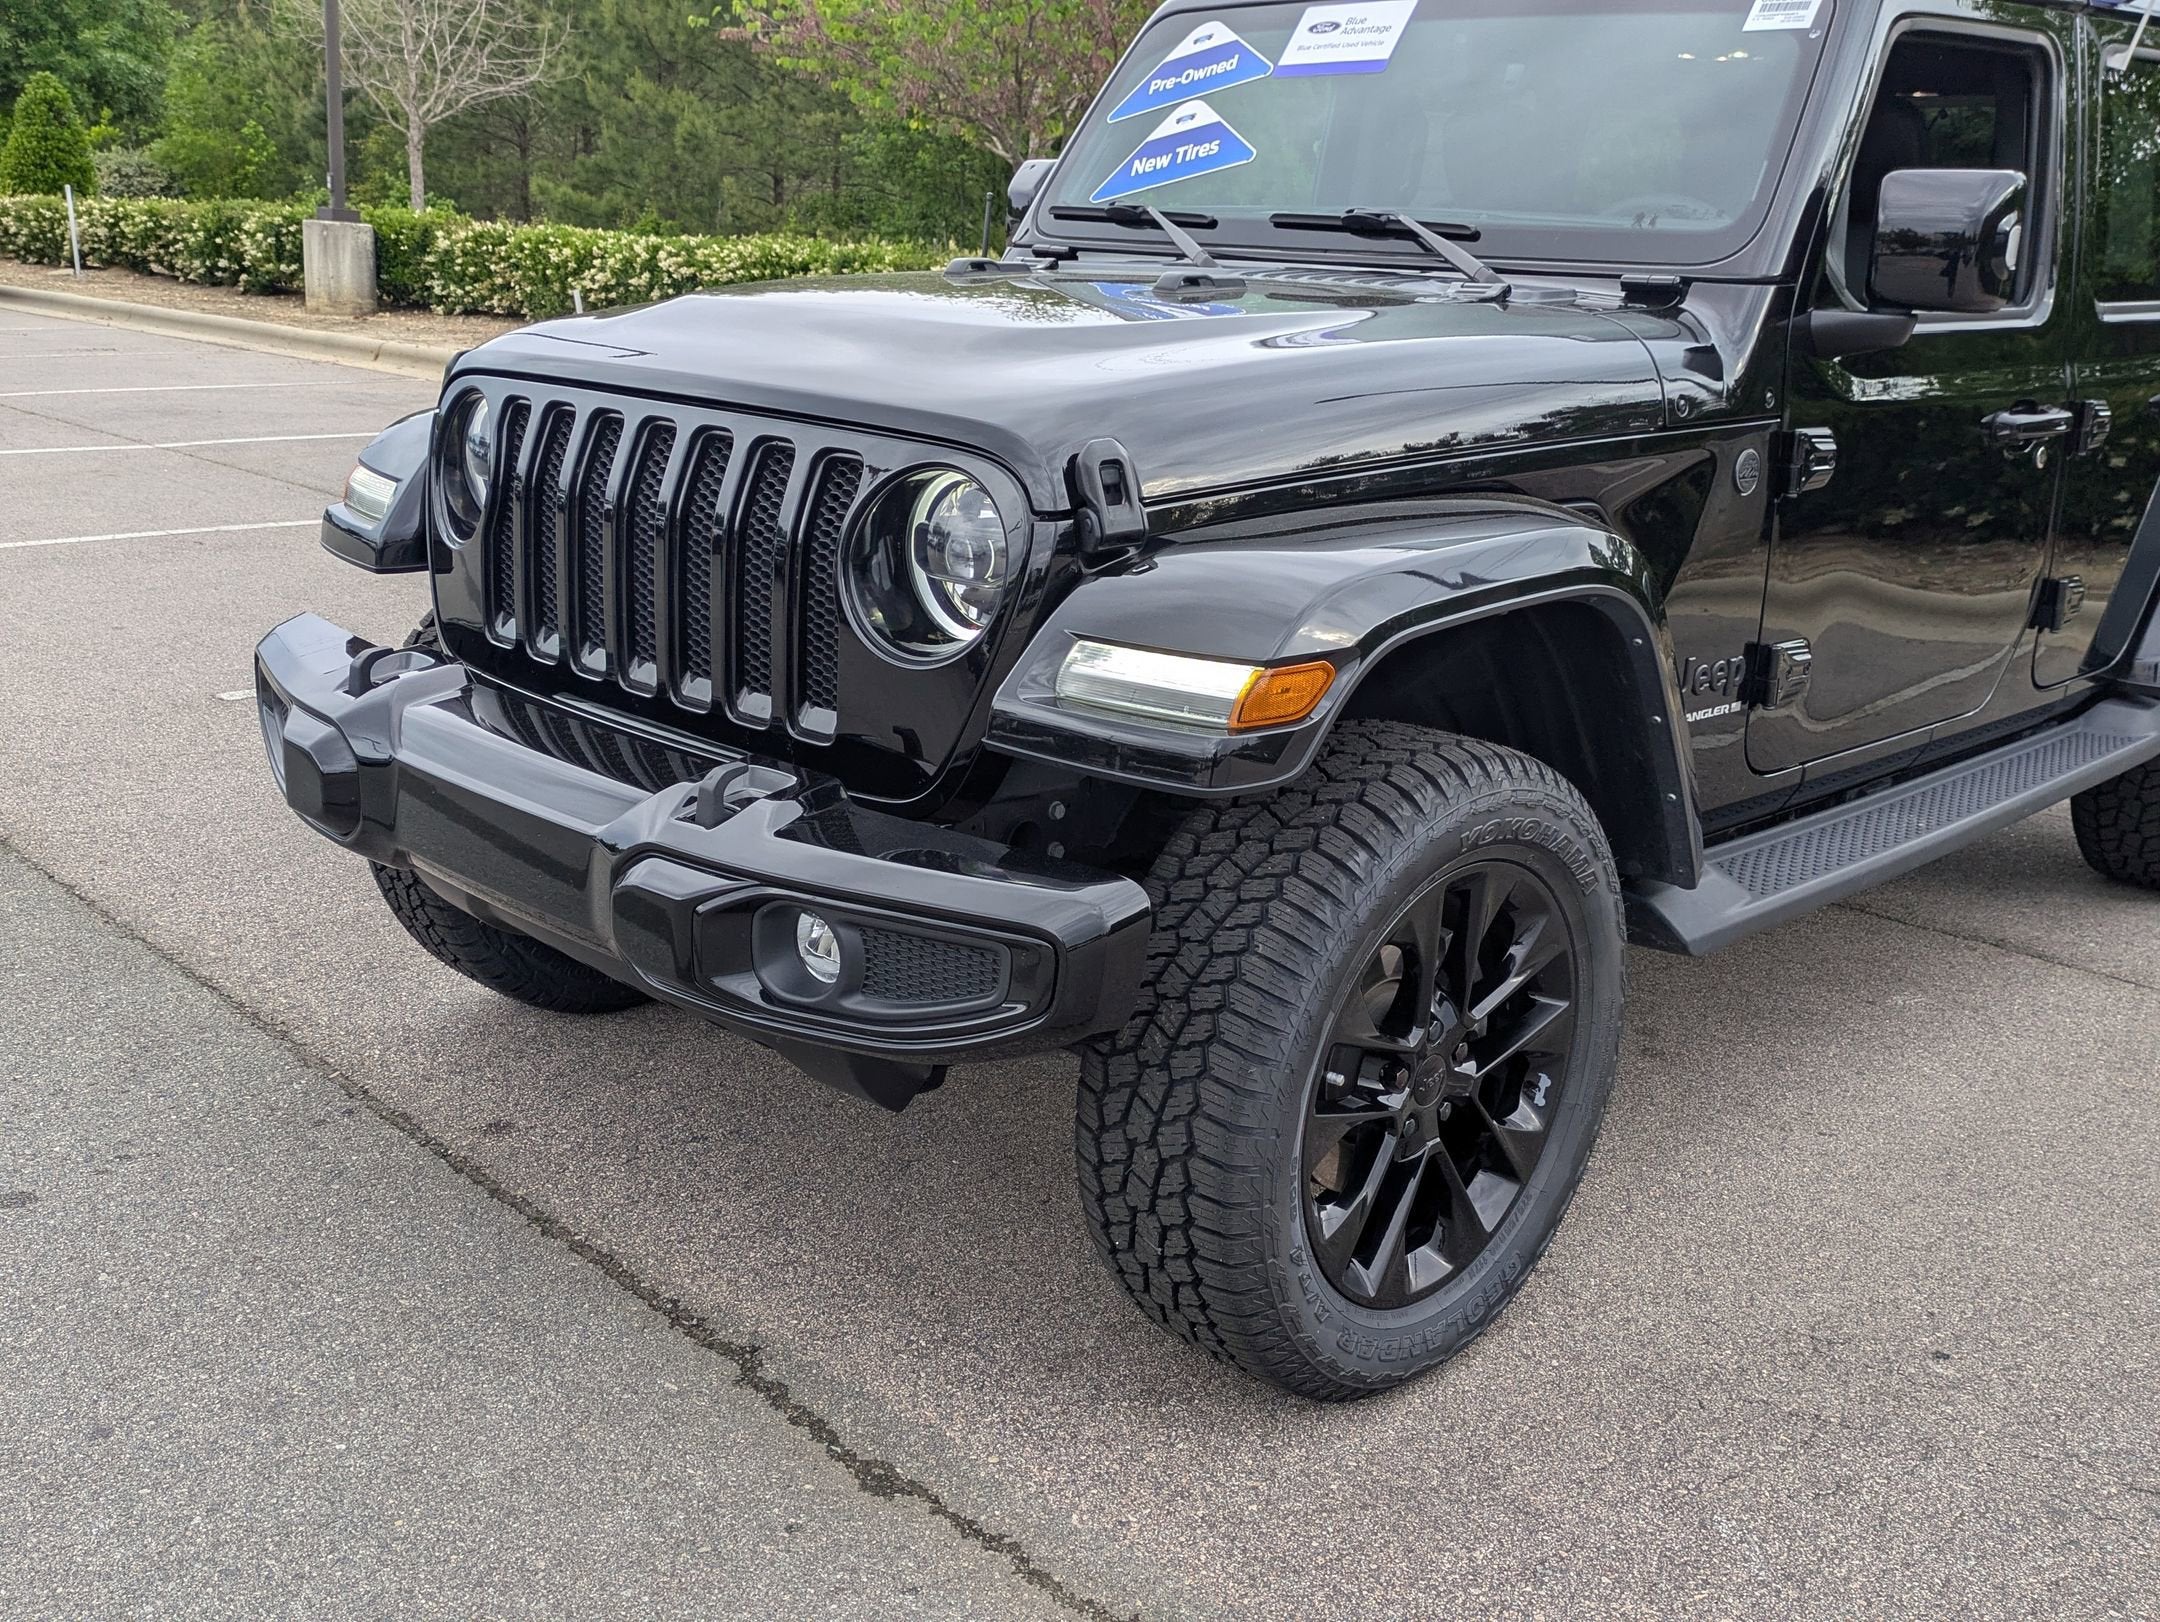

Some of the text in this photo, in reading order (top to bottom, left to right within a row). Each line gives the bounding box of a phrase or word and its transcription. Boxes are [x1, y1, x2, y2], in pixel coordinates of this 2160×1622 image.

[1311, 21, 1338, 34] Ford
[1340, 24, 1393, 36] Advantage
[1345, 17, 1368, 26] Blue
[1148, 54, 1242, 96] Pre-Owned
[1130, 138, 1221, 178] New Tires
[1681, 655, 1746, 697] Jeep
[1459, 817, 1600, 897] YOKOHAMA
[1337, 1252, 1525, 1363] GEOLANDAR
